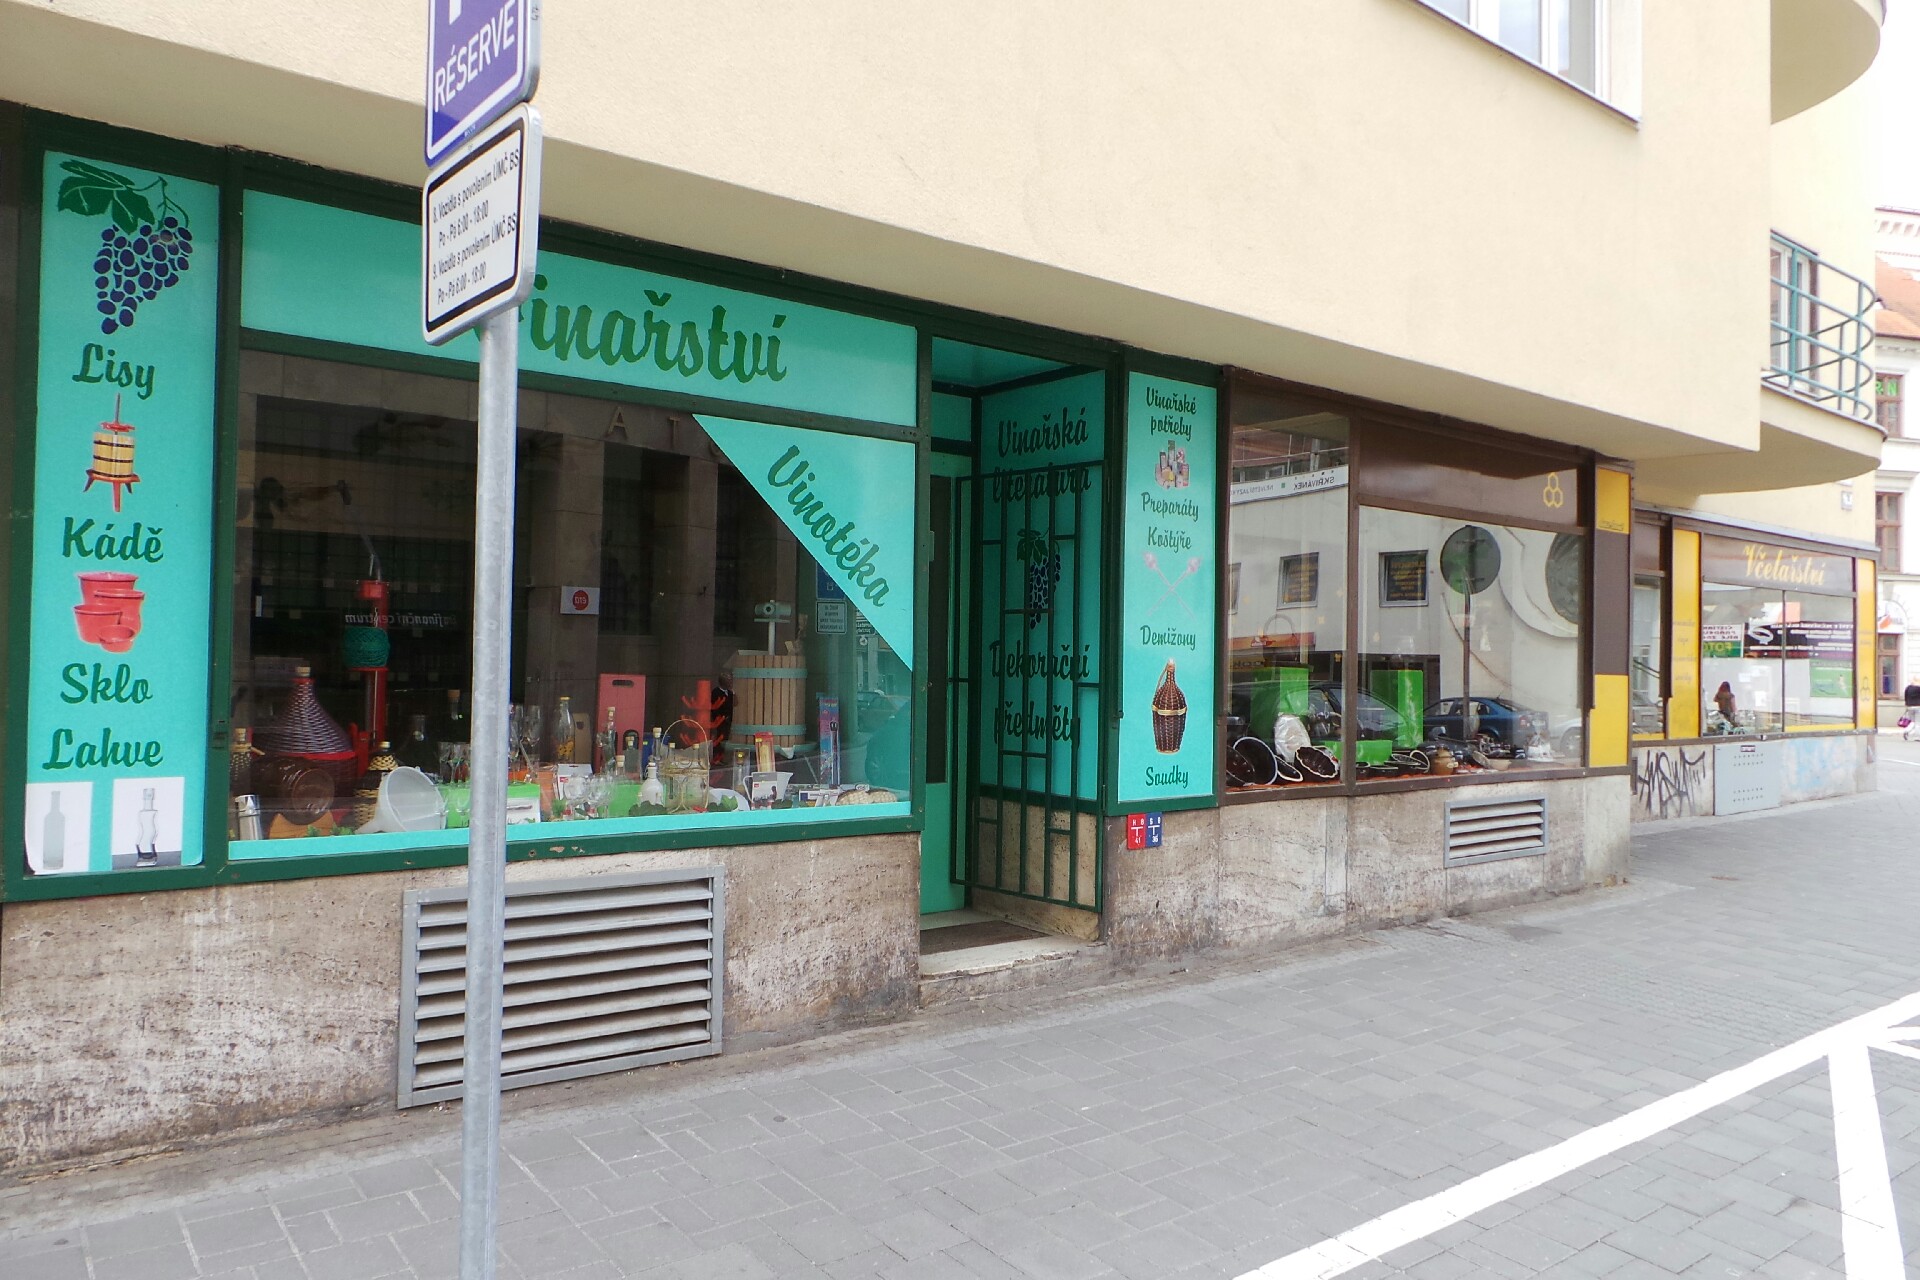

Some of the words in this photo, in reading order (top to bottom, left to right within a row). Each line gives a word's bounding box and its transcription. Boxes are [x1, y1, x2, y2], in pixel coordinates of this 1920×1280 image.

[433, 2, 516, 113] RÉSERVE
[438, 193, 457, 219] Vozidla
[462, 169, 492, 207] povolením
[493, 151, 508, 182] ÚMČ
[509, 148, 519, 171] BS
[437, 250, 456, 275] Vozidla
[461, 231, 491, 267] povolením
[491, 214, 506, 244] ÚMČ
[507, 211, 517, 235] BS
[438, 231, 446, 249] Po
[458, 212, 469, 237] 6:00
[473, 199, 489, 225] 18:00
[437, 287, 445, 305] Po
[471, 261, 487, 285] 18:00
[516, 272, 788, 384] inařství
[72, 342, 155, 401] Lisy
[1146, 386, 1197, 415] Vinařské
[998, 406, 1089, 458] Vinařská
[1150, 415, 1192, 442] potřeby
[992, 461, 1092, 503] lteaura
[767, 445, 890, 608] Vinotéka
[1141, 491, 1199, 522] Preparáty
[62, 516, 164, 563] Kádě
[1147, 526, 1192, 553] Koštýře
[1743, 543, 1826, 586] Včelařství
[1140, 624, 1197, 651] Demižony
[60, 662, 154, 705] Sklo
[41, 727, 164, 770] Lahve
[993, 701, 1081, 752] předmět
[1145, 766, 1190, 789] Soudky
